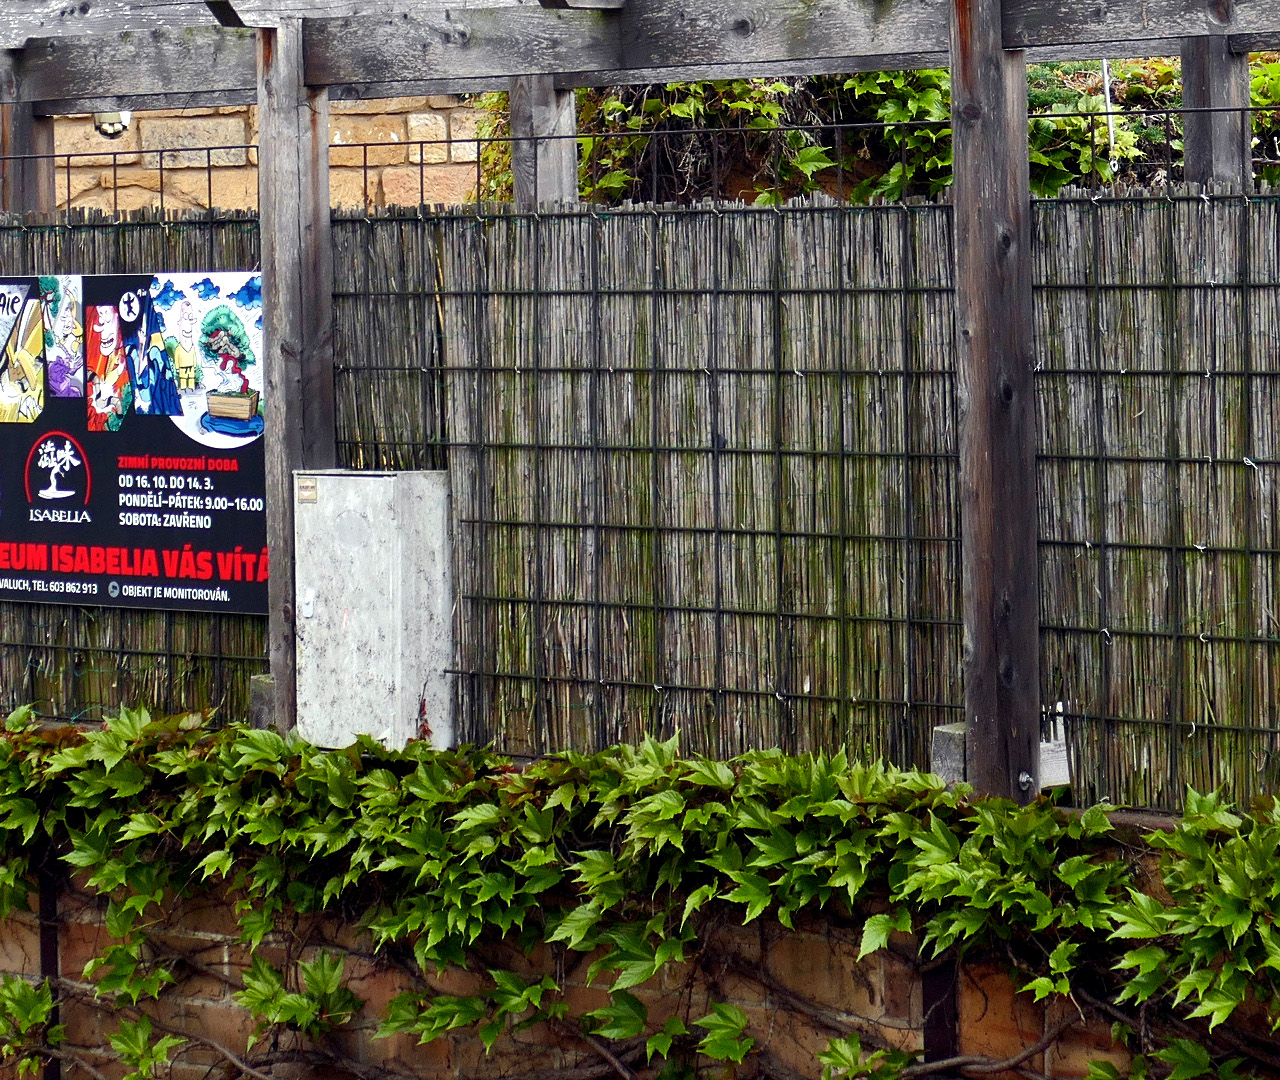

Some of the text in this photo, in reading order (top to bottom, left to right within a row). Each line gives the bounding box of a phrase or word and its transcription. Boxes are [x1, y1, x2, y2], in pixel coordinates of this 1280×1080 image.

[117, 454, 239, 471] ZIMNÍ PROVOZNÍ DOBA
[119, 474, 214, 490] OD 16. 10. DO 14. 3.
[29, 509, 91, 523] ISABELIA
[119, 511, 212, 529] SOBOTA: ZAVŘENO
[51, 544, 160, 577] ISABELIA
[162, 543, 213, 580] VÁS
[0, 579, 31, 592] VALUCH,
[32, 580, 49, 591] TEL:
[49, 580, 64, 593] 603
[65, 582, 81, 594] 862
[82, 583, 98, 594] 913
[122, 585, 231, 602] OBJEKT JE MONITOROVÁN.
